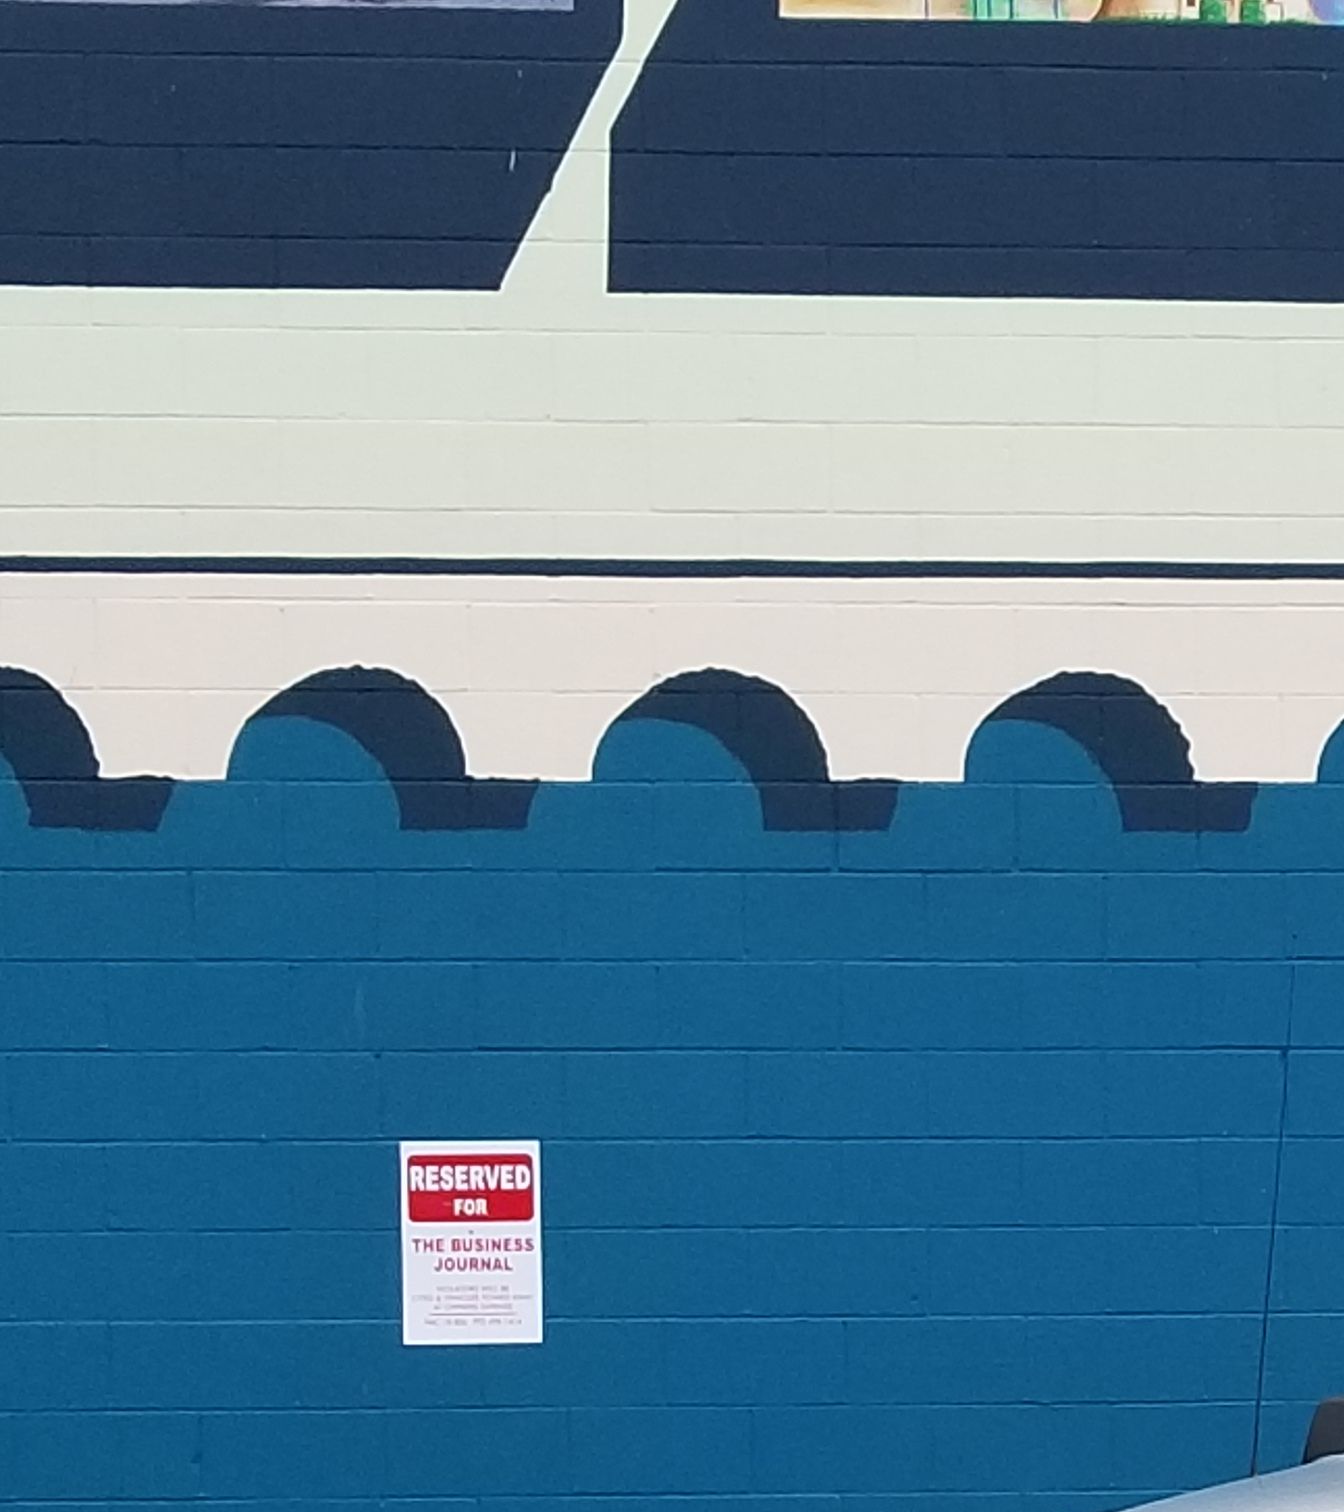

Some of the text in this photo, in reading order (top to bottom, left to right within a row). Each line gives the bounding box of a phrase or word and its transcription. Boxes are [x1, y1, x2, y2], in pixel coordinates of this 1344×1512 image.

[410, 1165, 531, 1191] RESERVED
[453, 1198, 488, 1216] FOR
[412, 1238, 534, 1252] THE BUSINESS
[434, 1257, 513, 1272] JOURNAL
